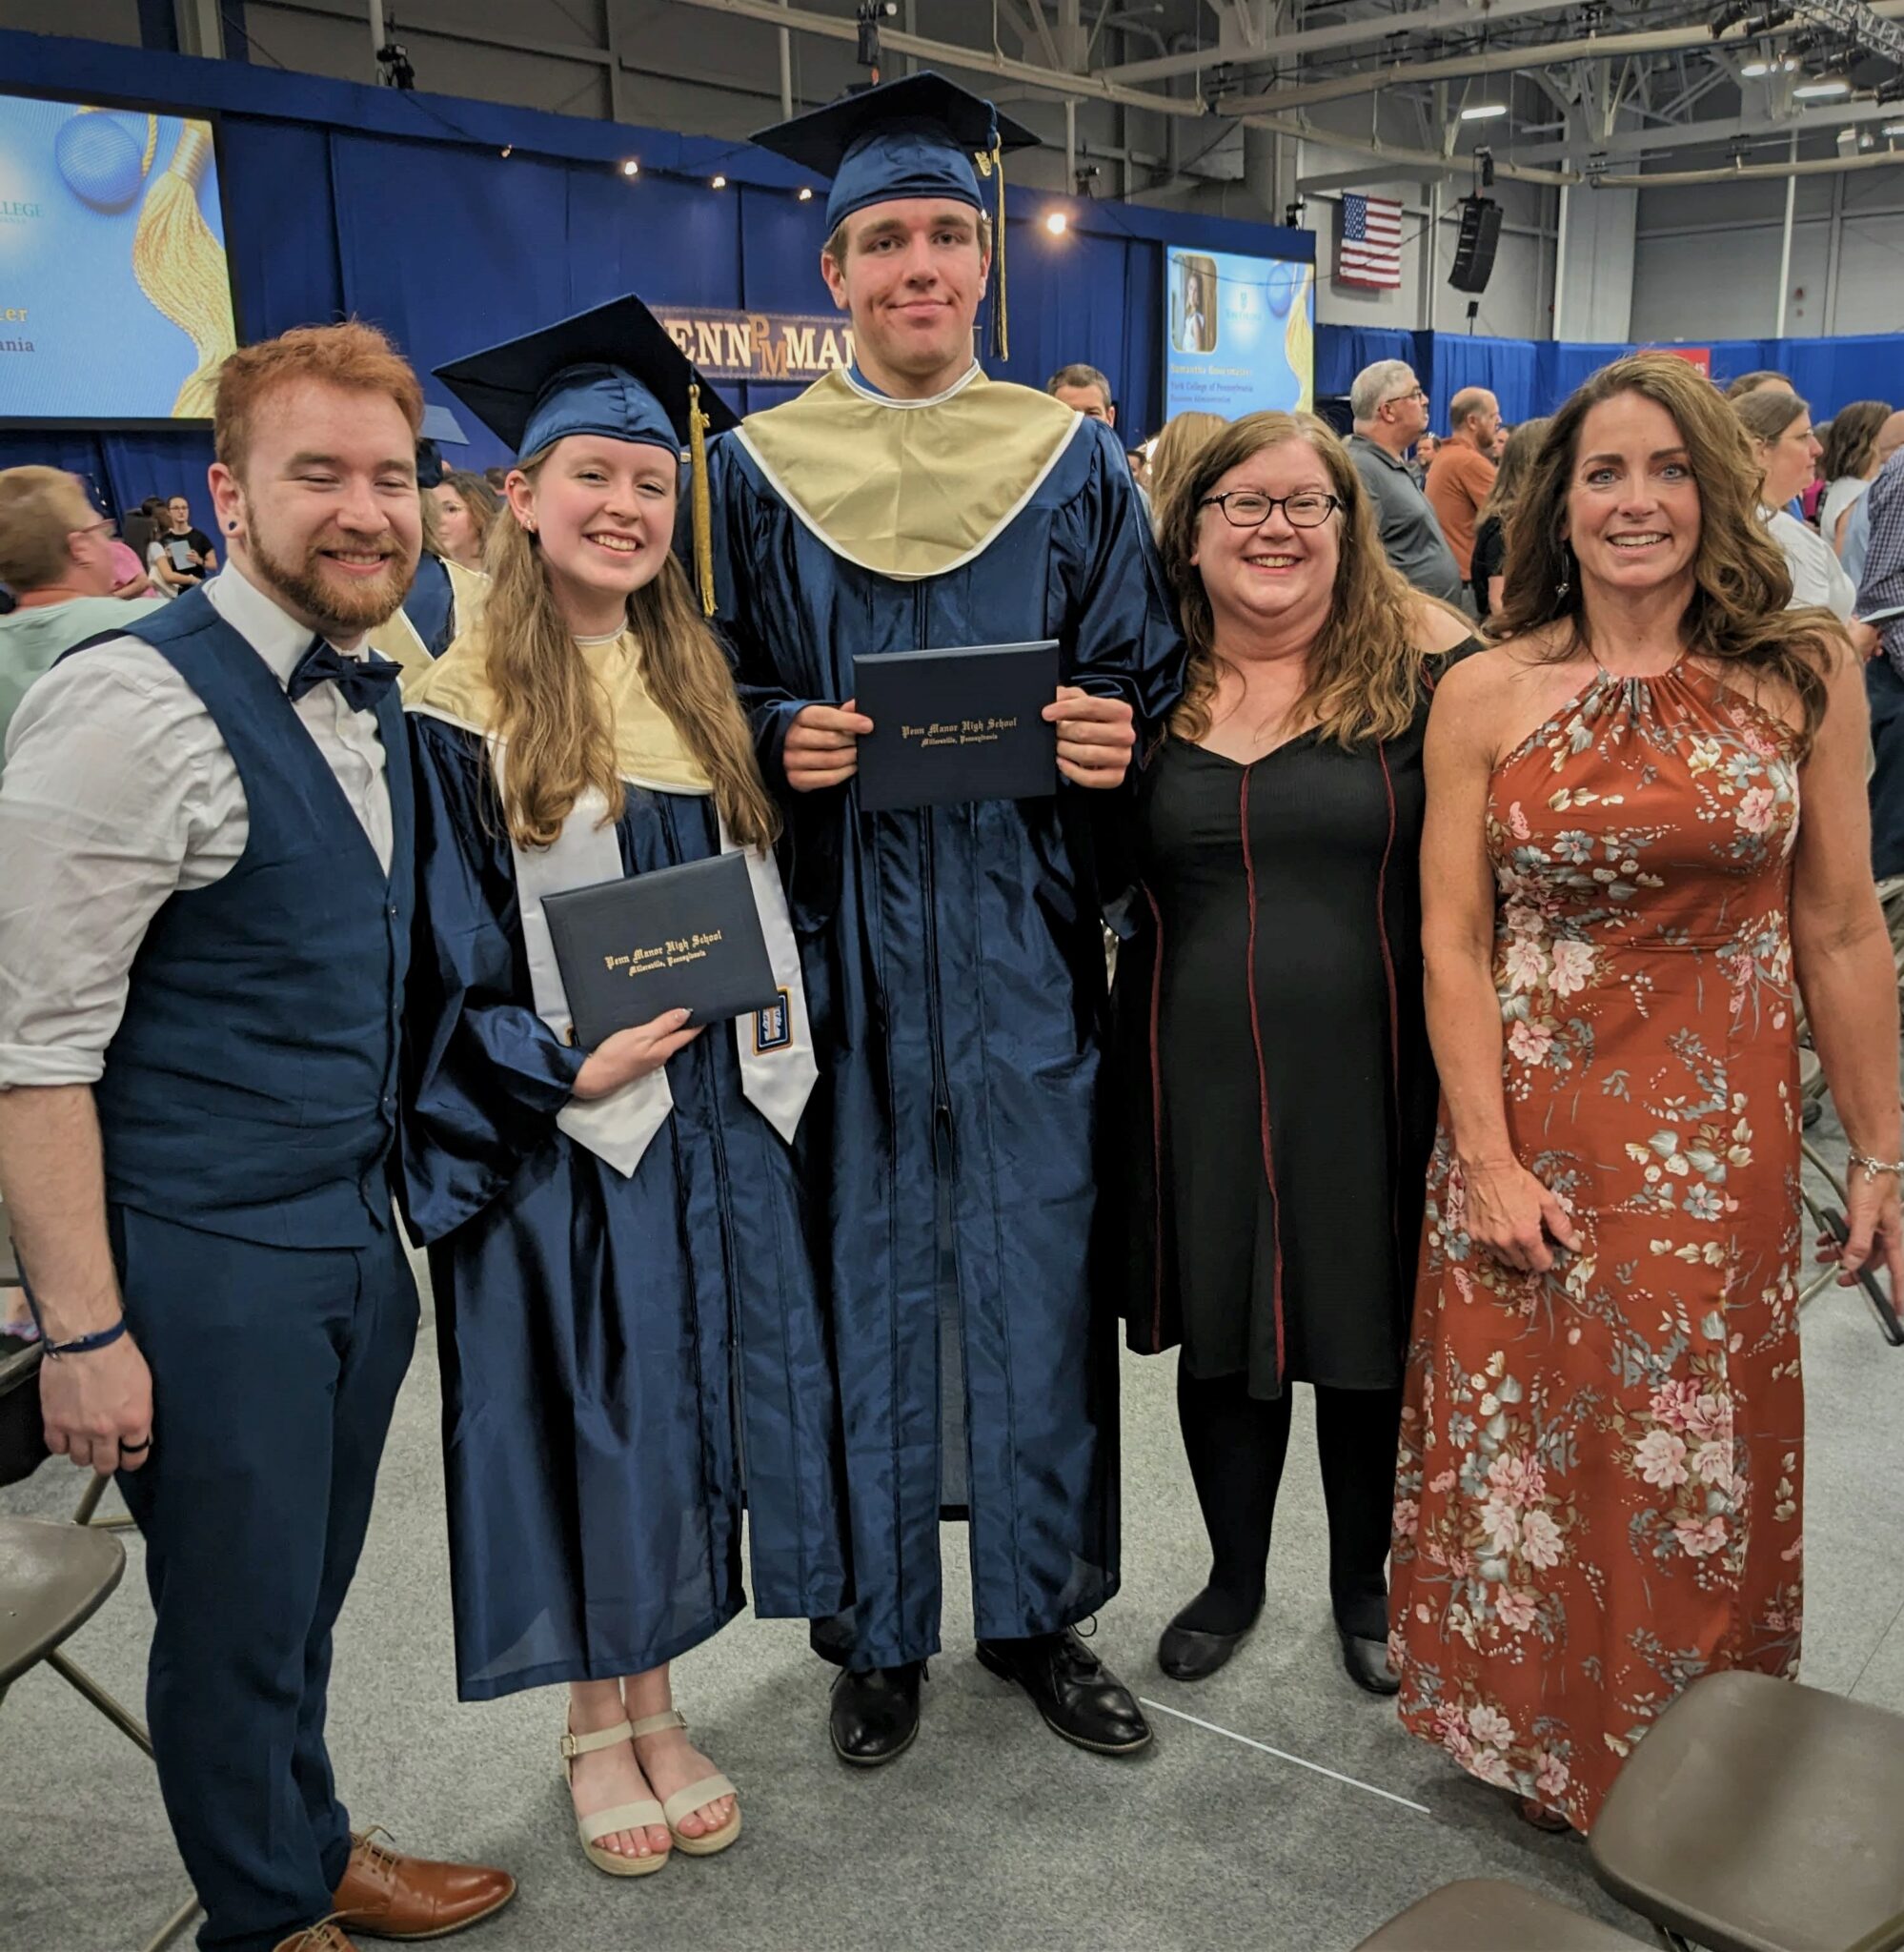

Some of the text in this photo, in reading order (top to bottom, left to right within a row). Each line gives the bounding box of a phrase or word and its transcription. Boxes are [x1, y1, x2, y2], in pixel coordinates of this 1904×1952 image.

[664, 319, 752, 367] ENN
[901, 717, 1017, 739] Penn Manor High School
[604, 929, 722, 970] Penn Manor High School
